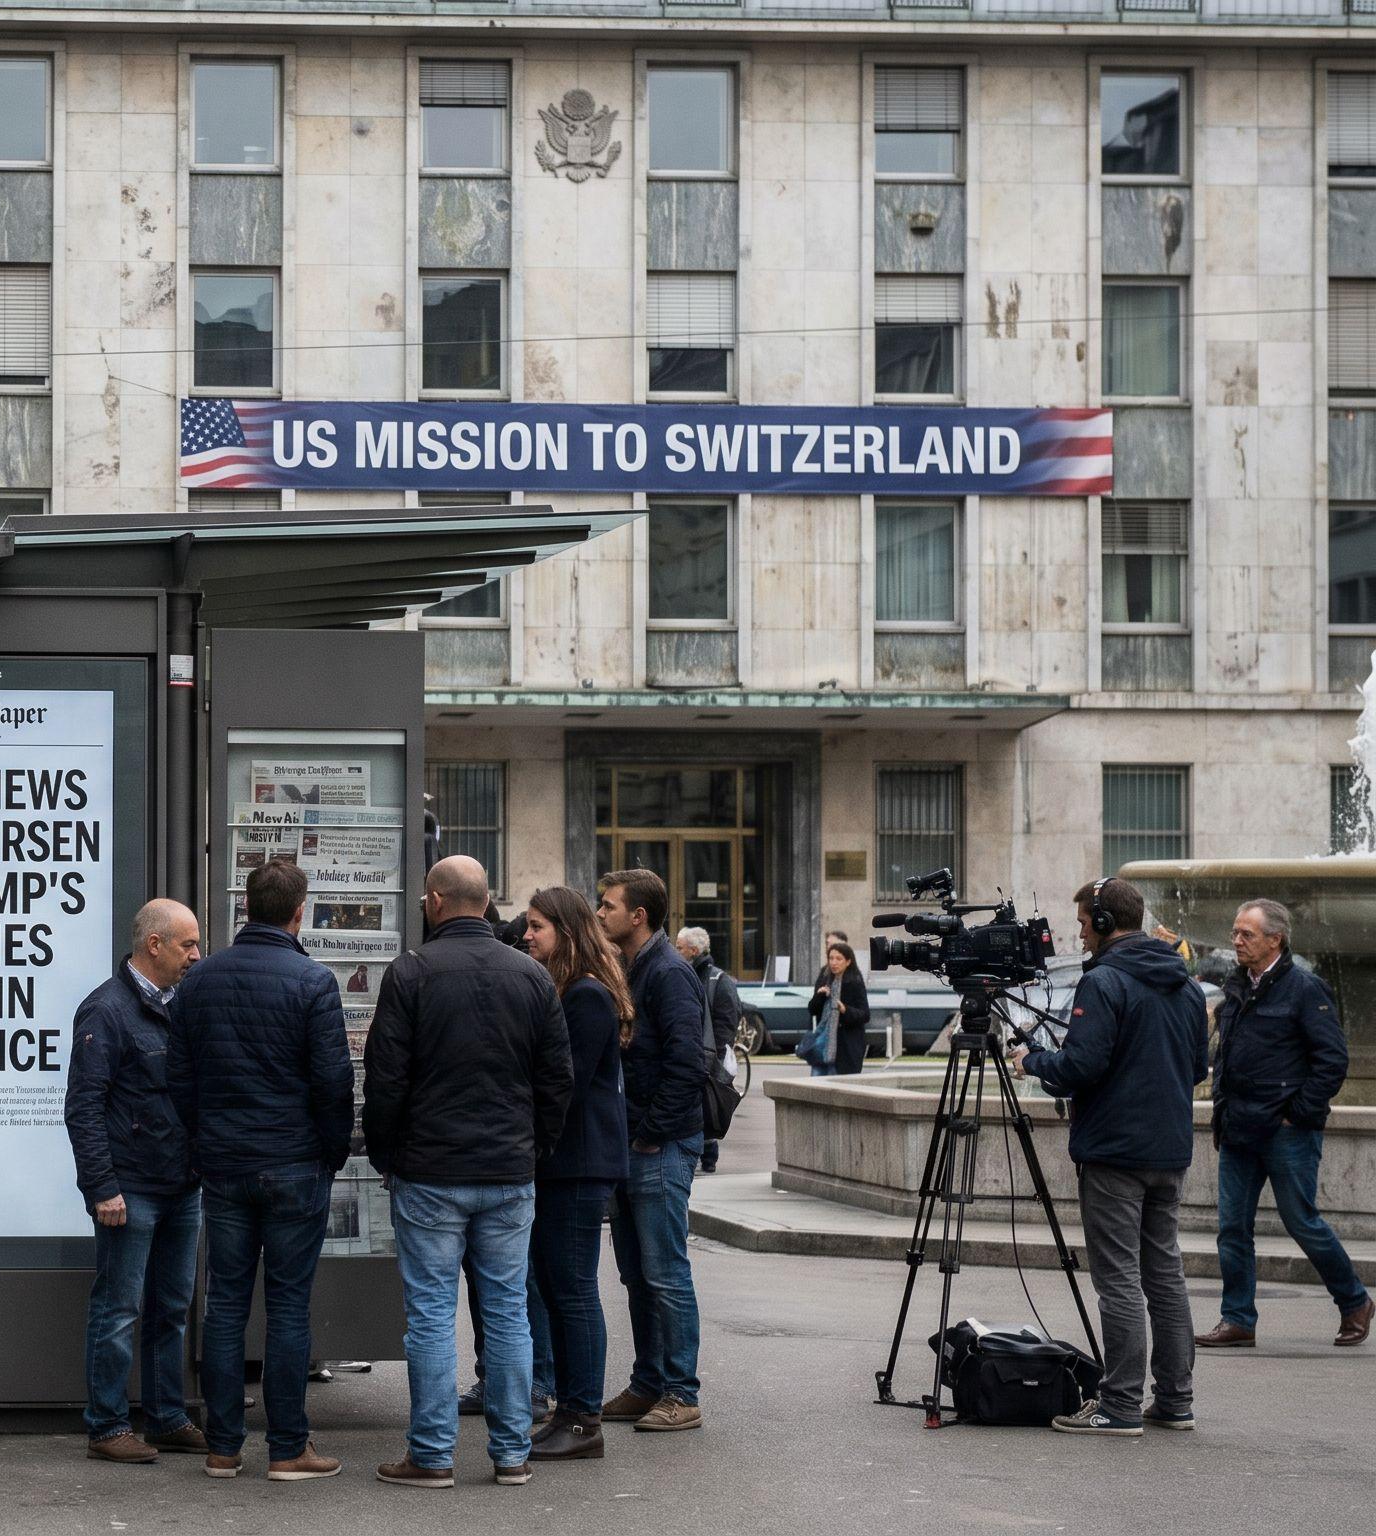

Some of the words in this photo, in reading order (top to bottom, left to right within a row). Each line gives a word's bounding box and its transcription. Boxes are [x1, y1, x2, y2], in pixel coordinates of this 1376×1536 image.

[273, 419, 338, 469] US
[355, 420, 568, 471] MISSION
[582, 423, 647, 472] TO
[665, 423, 1021, 475] SWITZERLAND
